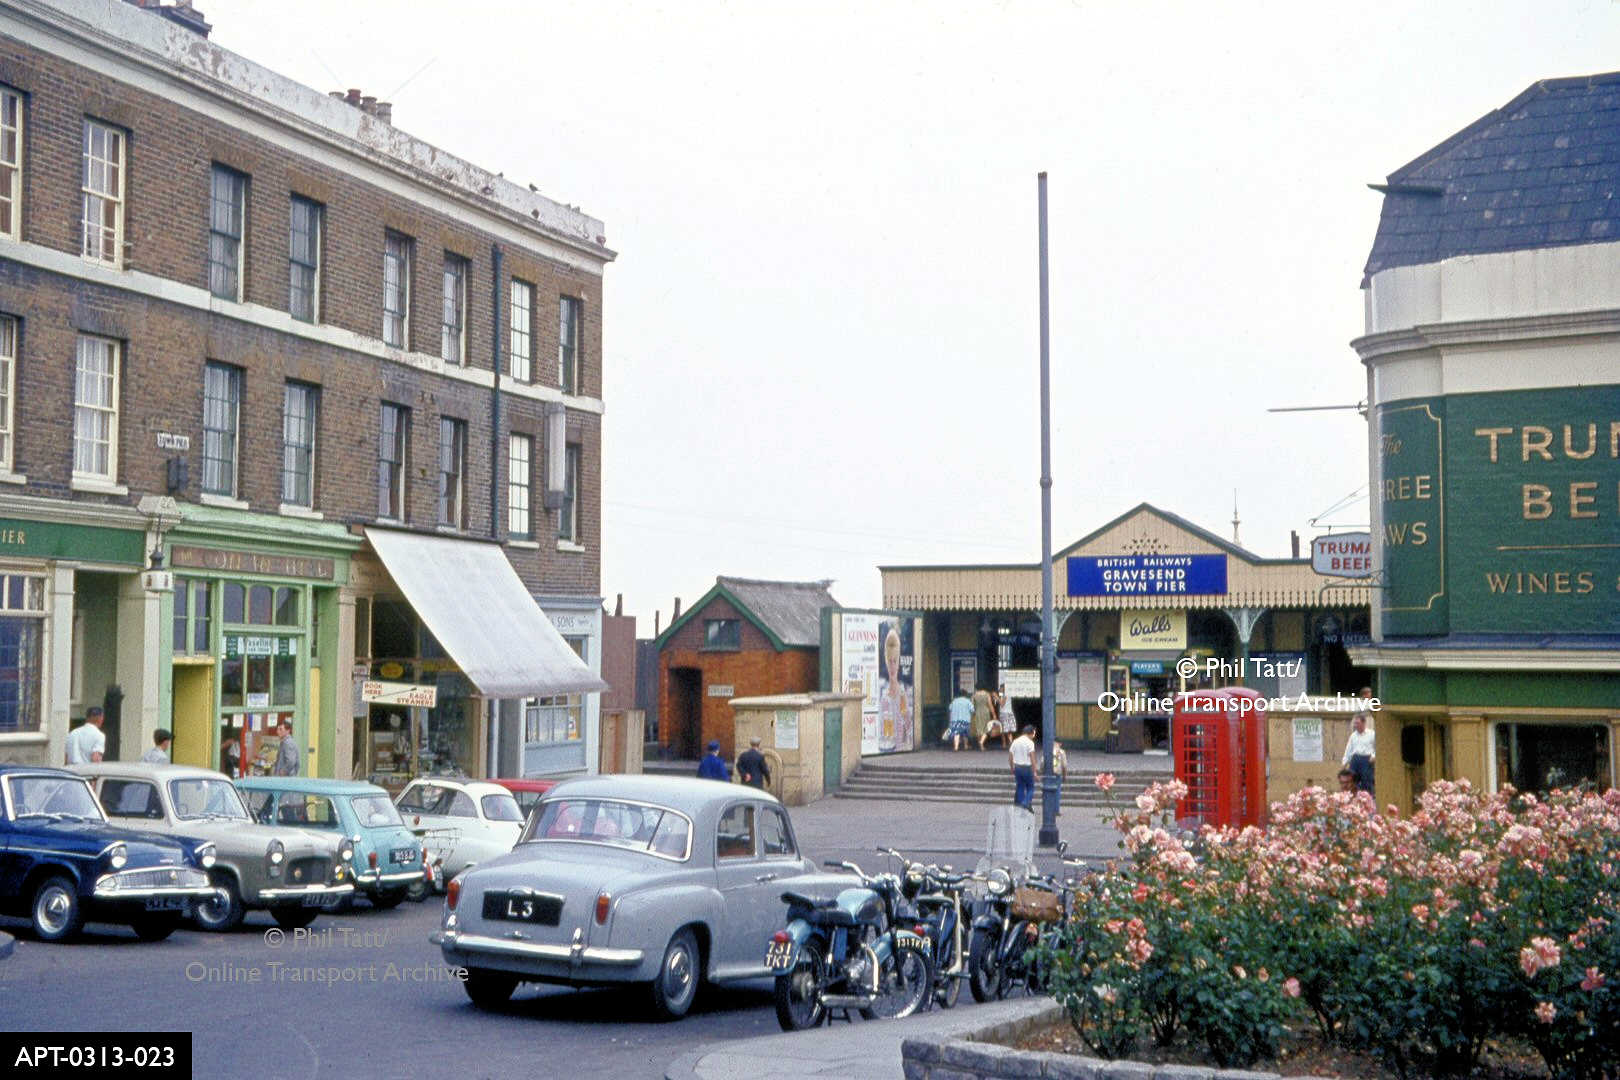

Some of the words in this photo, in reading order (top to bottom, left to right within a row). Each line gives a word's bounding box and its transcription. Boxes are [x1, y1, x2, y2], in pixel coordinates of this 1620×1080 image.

[1382, 475, 1431, 501] REE
[1523, 482, 1620, 520] BE
[1097, 558, 1136, 568] BRITISH
[1143, 556, 1193, 567] RAILWAYS
[1103, 568, 1186, 581] GRAVESEND
[1104, 580, 1148, 593] TOWN
[1156, 580, 1187, 593] PIER
[1486, 570, 1594, 594] WINES
[396, 697, 433, 706] STEAMERS
[409, 692, 433, 700] EAGLE
[767, 940, 792, 955] 731
[765, 953, 791, 969] TKT
